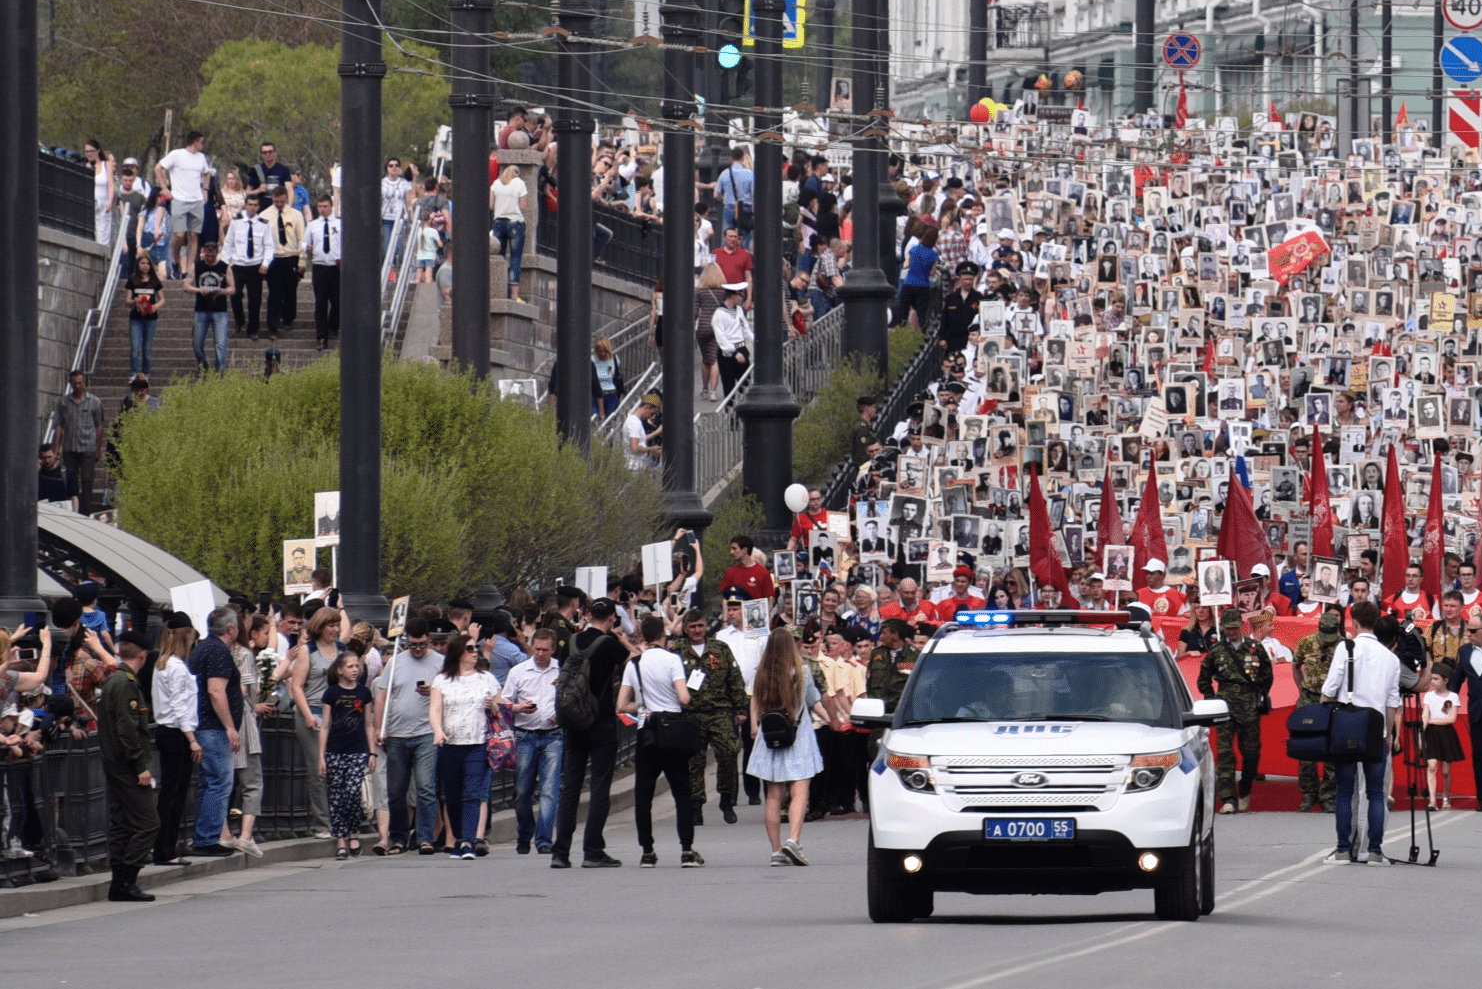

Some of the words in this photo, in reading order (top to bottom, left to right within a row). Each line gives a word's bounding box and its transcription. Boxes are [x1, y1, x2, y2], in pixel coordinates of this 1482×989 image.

[994, 726, 1072, 734] ДПС
[1018, 773, 1041, 784] Ford
[1007, 822, 1045, 837] 0700
[1053, 821, 1069, 832] 55
